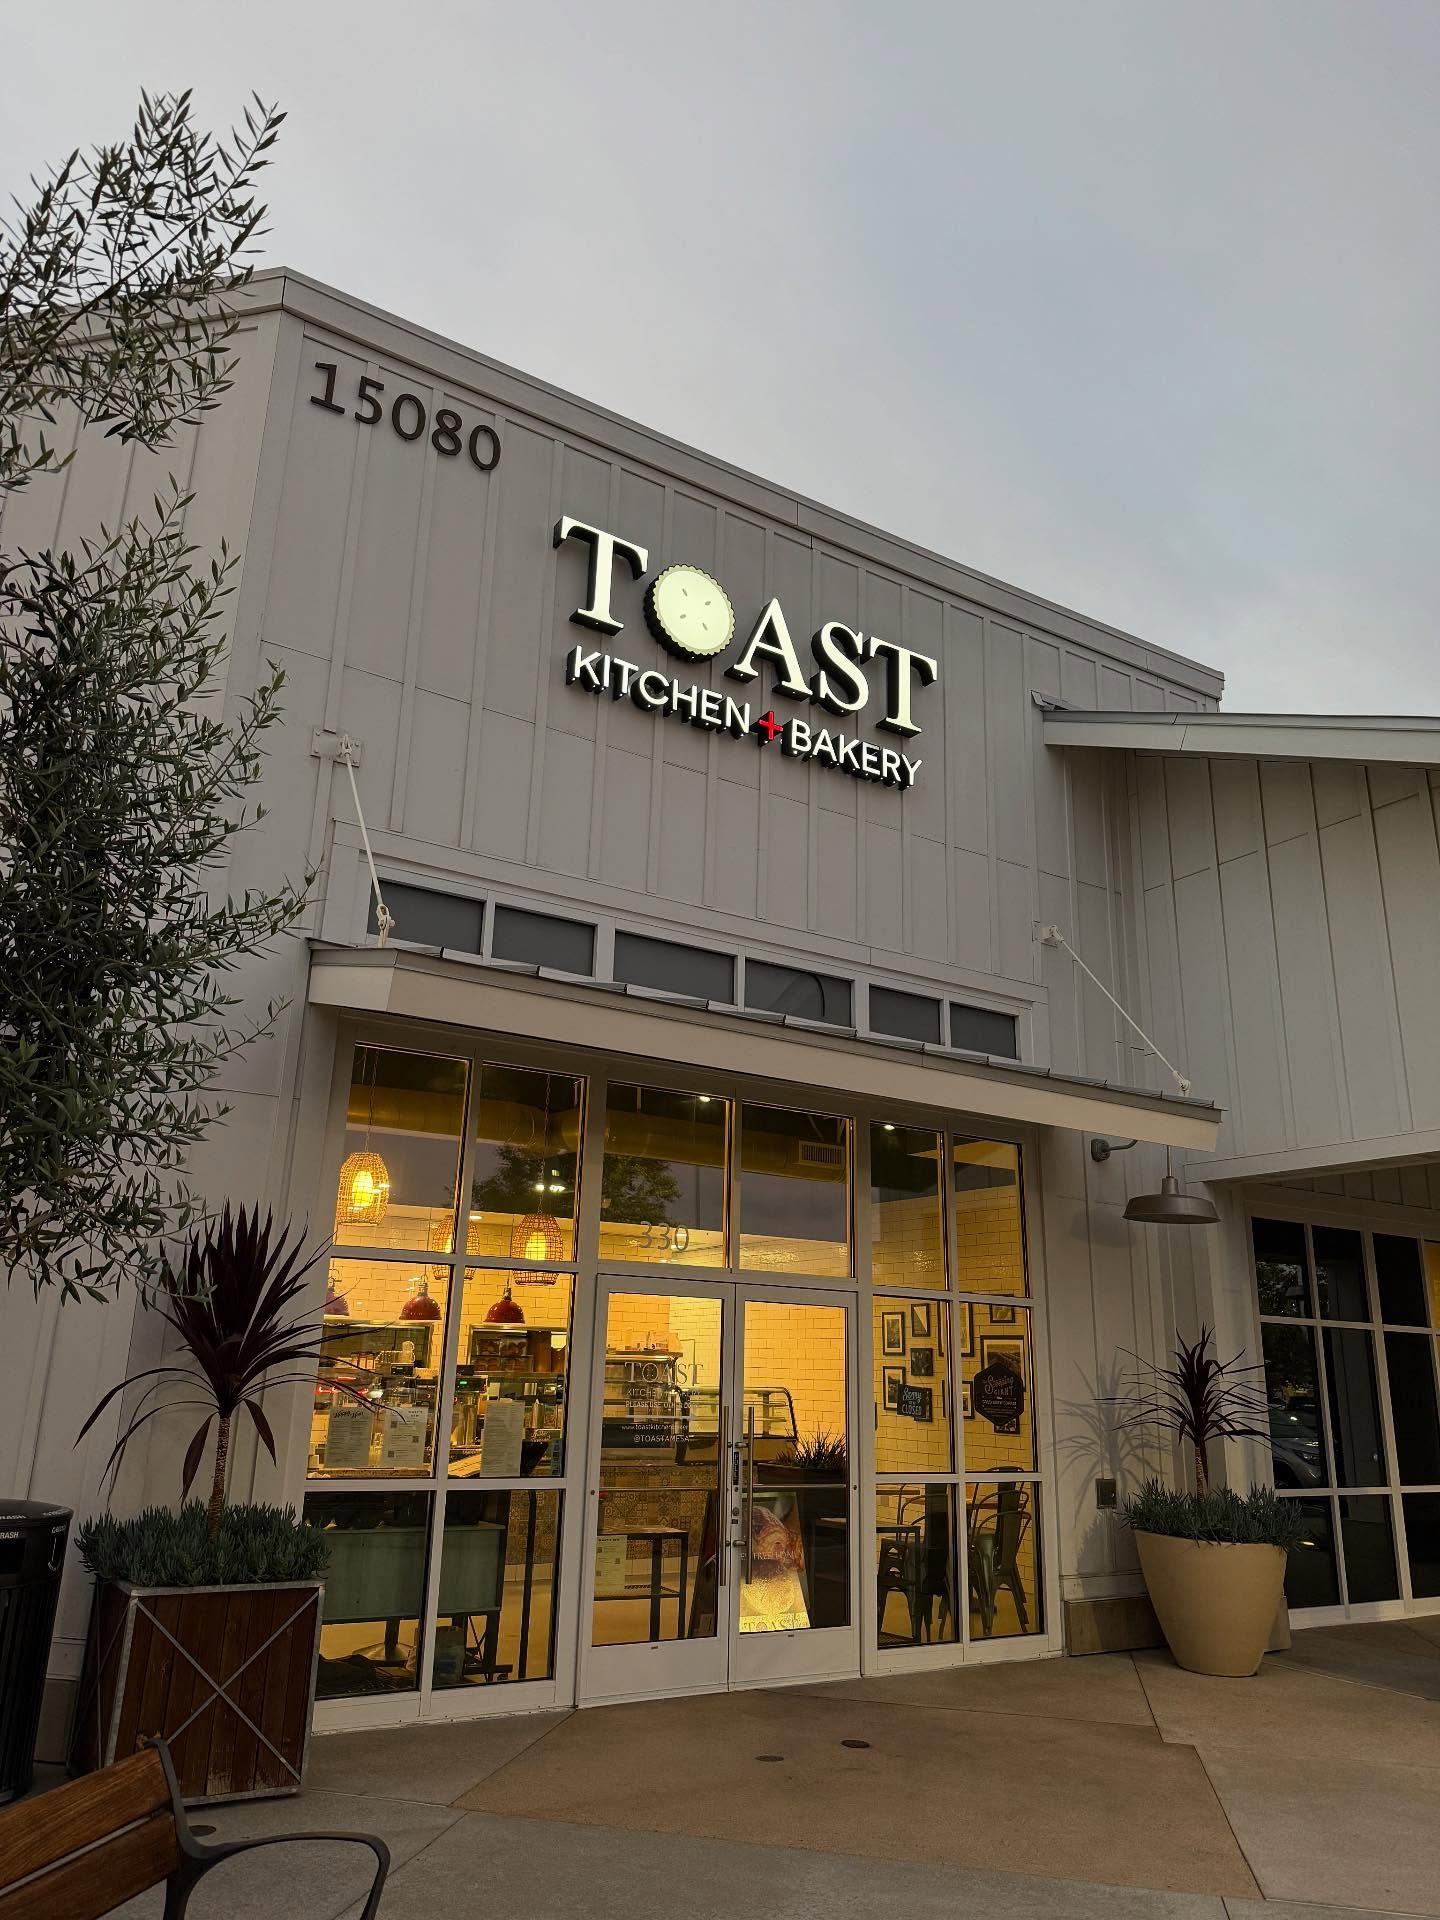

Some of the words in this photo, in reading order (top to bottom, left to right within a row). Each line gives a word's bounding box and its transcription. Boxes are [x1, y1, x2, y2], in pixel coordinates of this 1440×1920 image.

[311, 362, 501, 470] 15080
[554, 515, 938, 737] TOAST
[568, 645, 750, 739] KITCHEN
[787, 718, 922, 789] BAKERY
[640, 1221, 689, 1251] 330
[624, 1361, 704, 1386] TOAST
[0, 1531, 20, 1539] RASH
